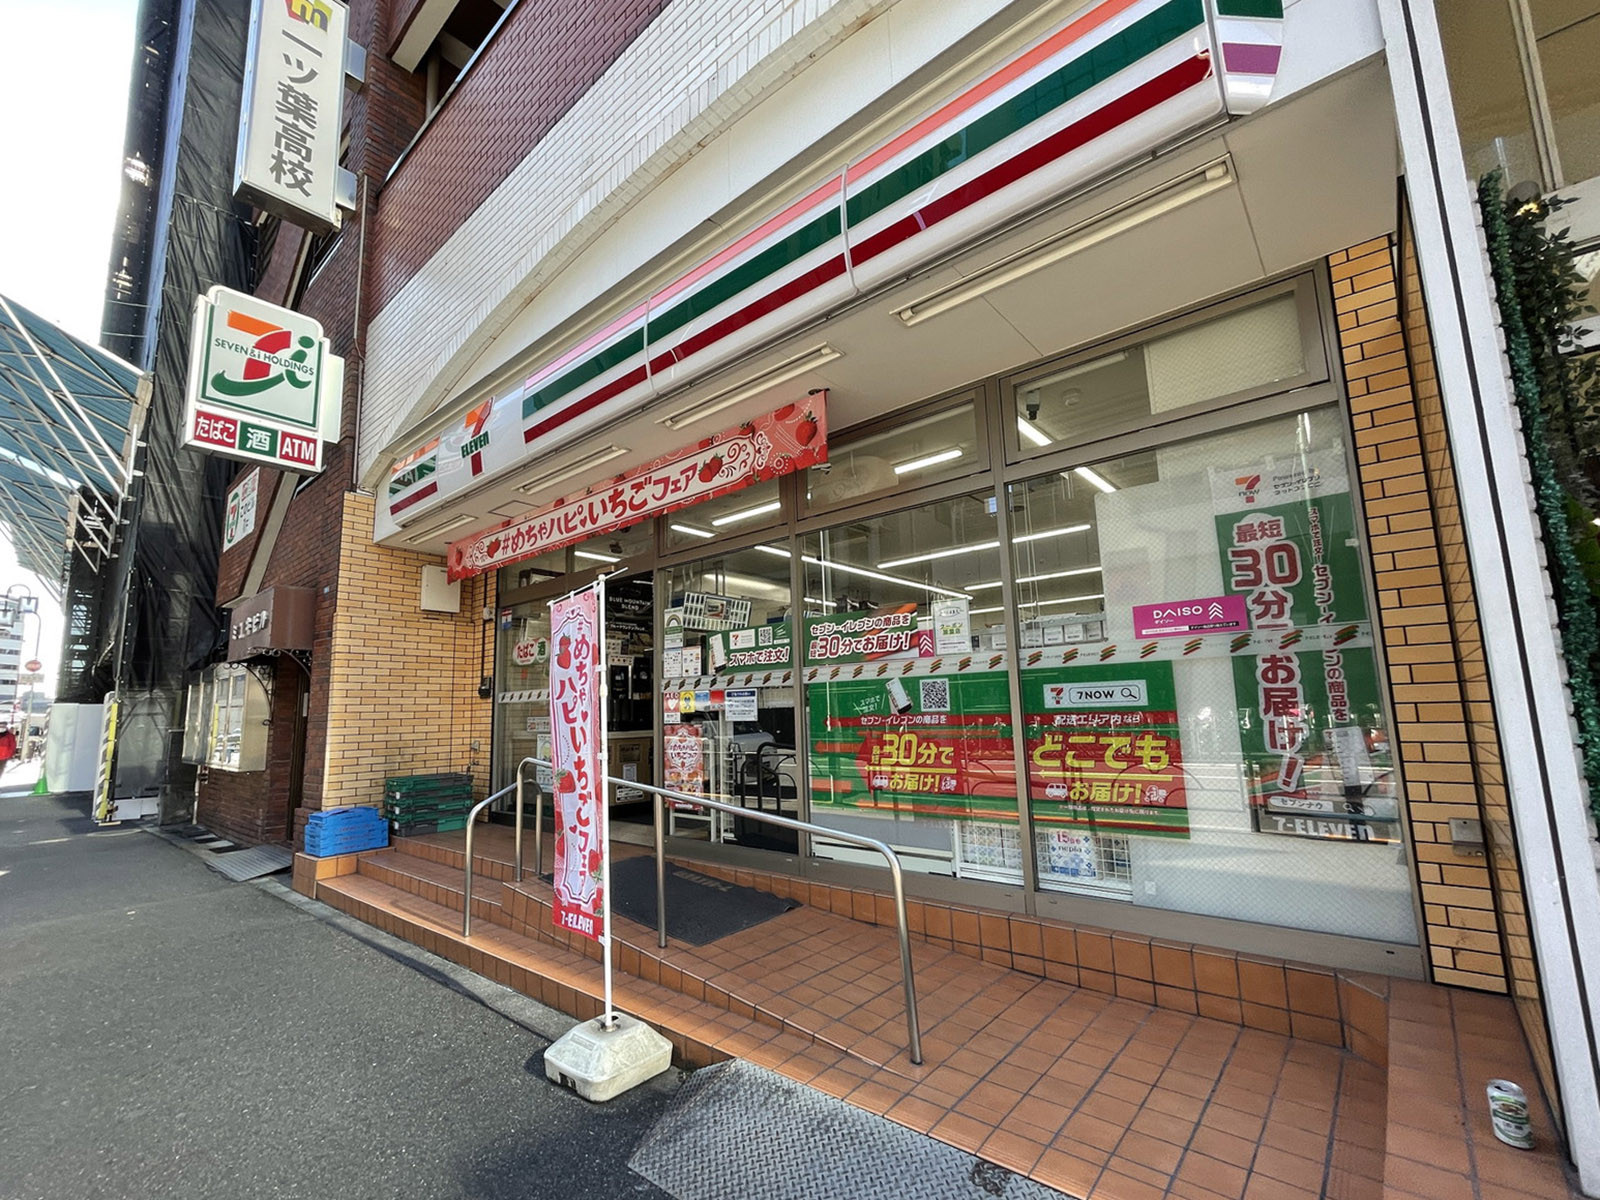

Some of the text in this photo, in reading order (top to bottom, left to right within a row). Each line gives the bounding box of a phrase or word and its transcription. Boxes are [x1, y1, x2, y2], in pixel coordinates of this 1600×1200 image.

[270, 29, 323, 198] 一ツ葉高校
[263, 352, 314, 377] HOLDINGS
[196, 415, 315, 462] たばこ 酒 ATM
[1236, 519, 1283, 544] 最短
[1230, 543, 1300, 588] 30
[1153, 605, 1203, 619] DAISO
[516, 642, 536, 659] たばこ
[730, 647, 790, 666] スマホで注文!
[1076, 690, 1115, 700] 7NOW
[1032, 733, 1170, 772] どこでも
[889, 773, 941, 793] お届け!
[1068, 781, 1142, 805] お届け!
[1281, 797, 1324, 810] セブンナウ
